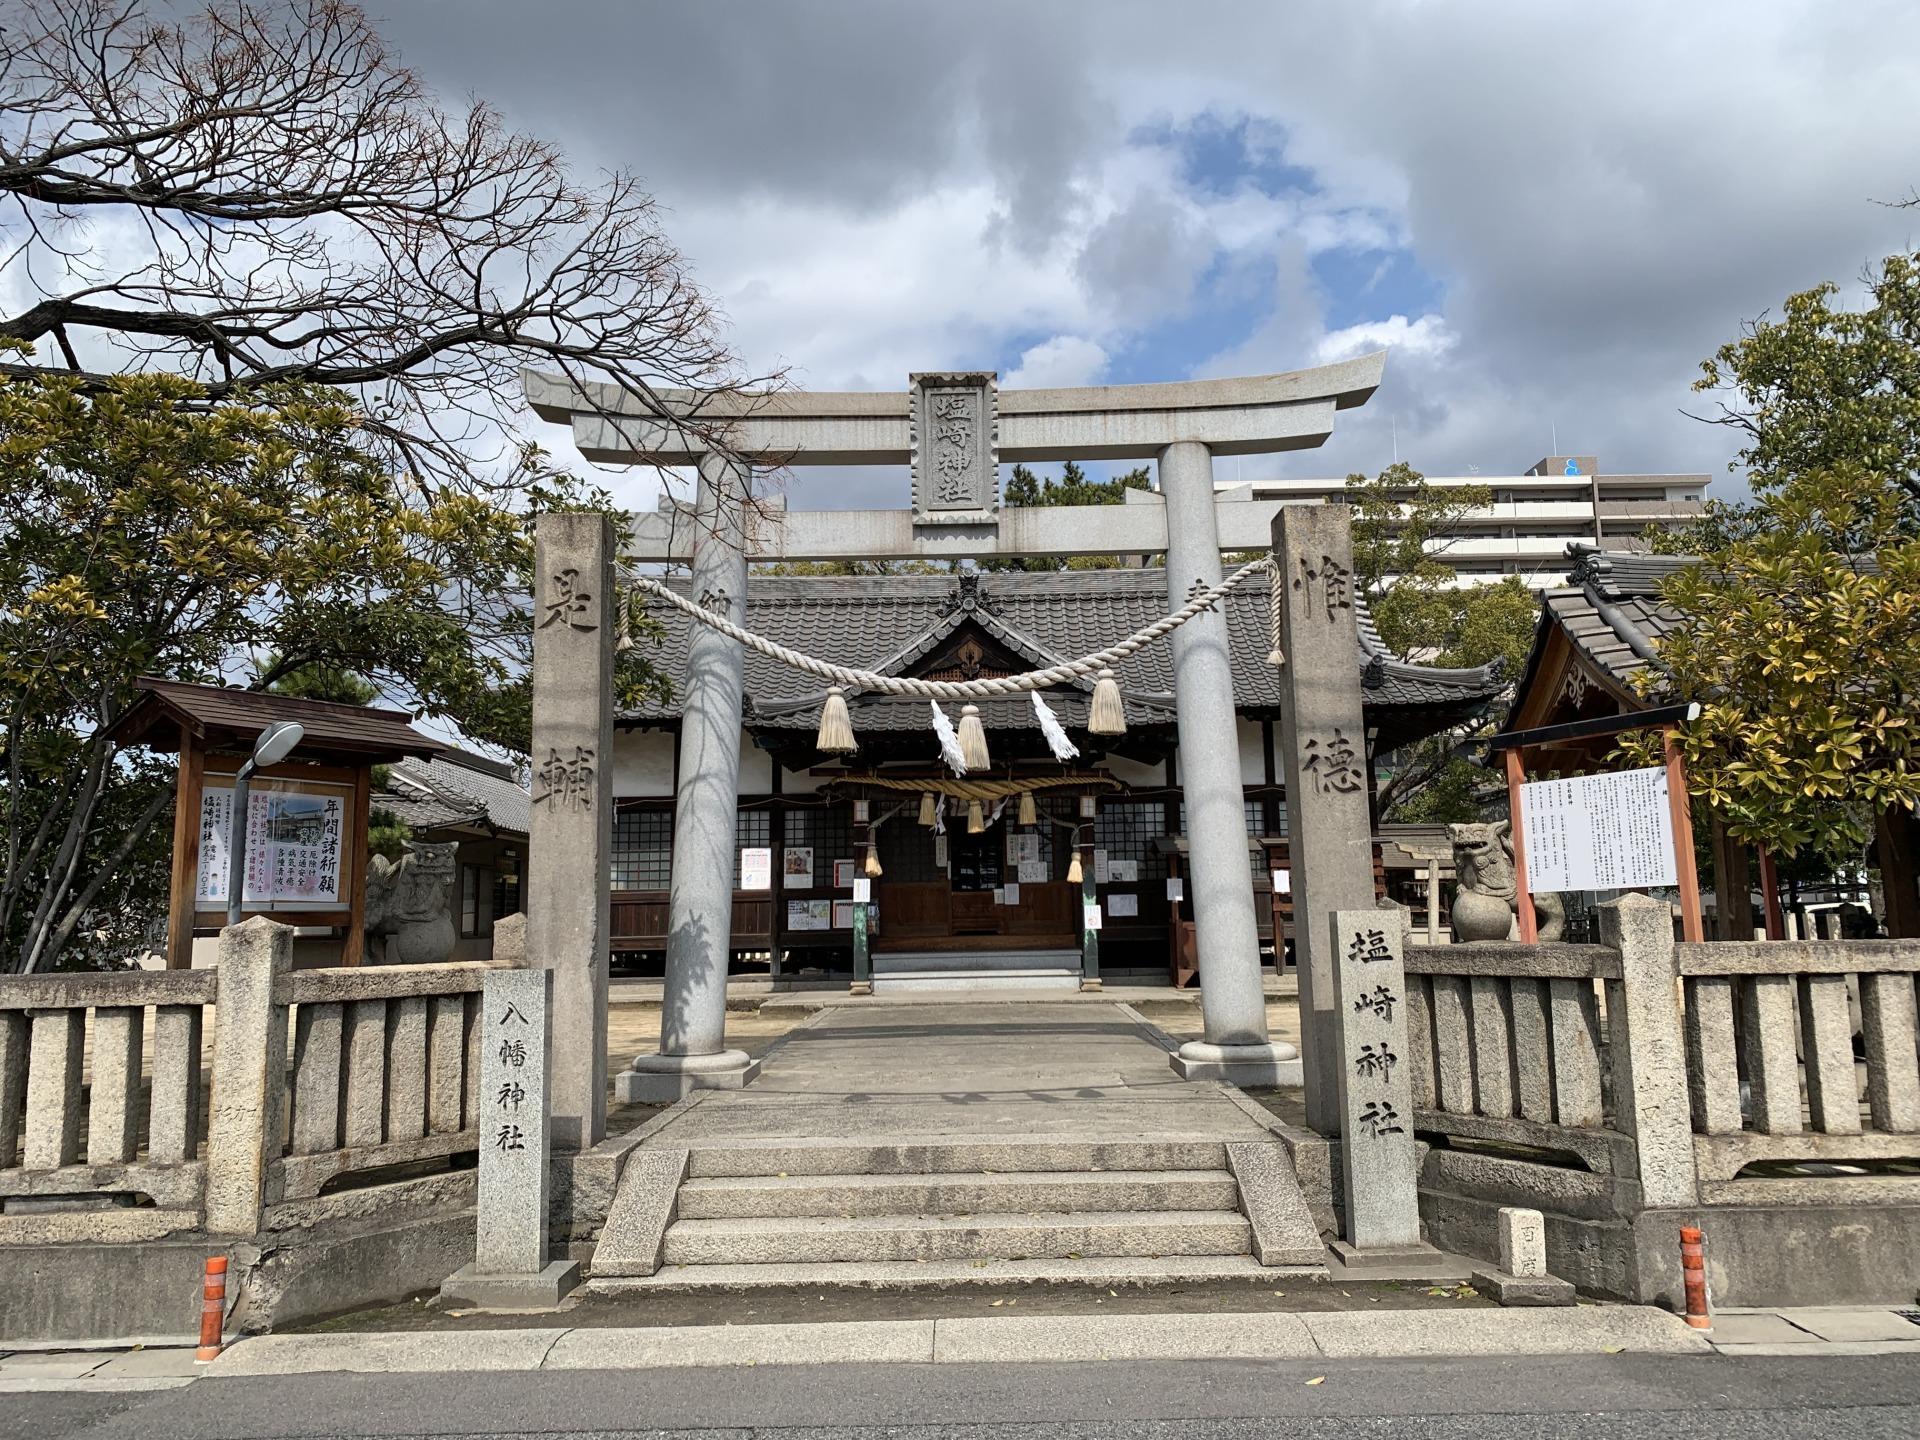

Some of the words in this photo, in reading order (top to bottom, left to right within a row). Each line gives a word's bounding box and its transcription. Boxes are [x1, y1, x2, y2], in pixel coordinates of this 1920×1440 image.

[936, 395, 972, 503] 塩崎神社
[297, 849, 307, 887] 交通安全
[318, 799, 339, 894] 年間諸祈願
[495, 1001, 529, 1152] 八幡神社
[1347, 928, 1404, 1139] 塩崎神社
